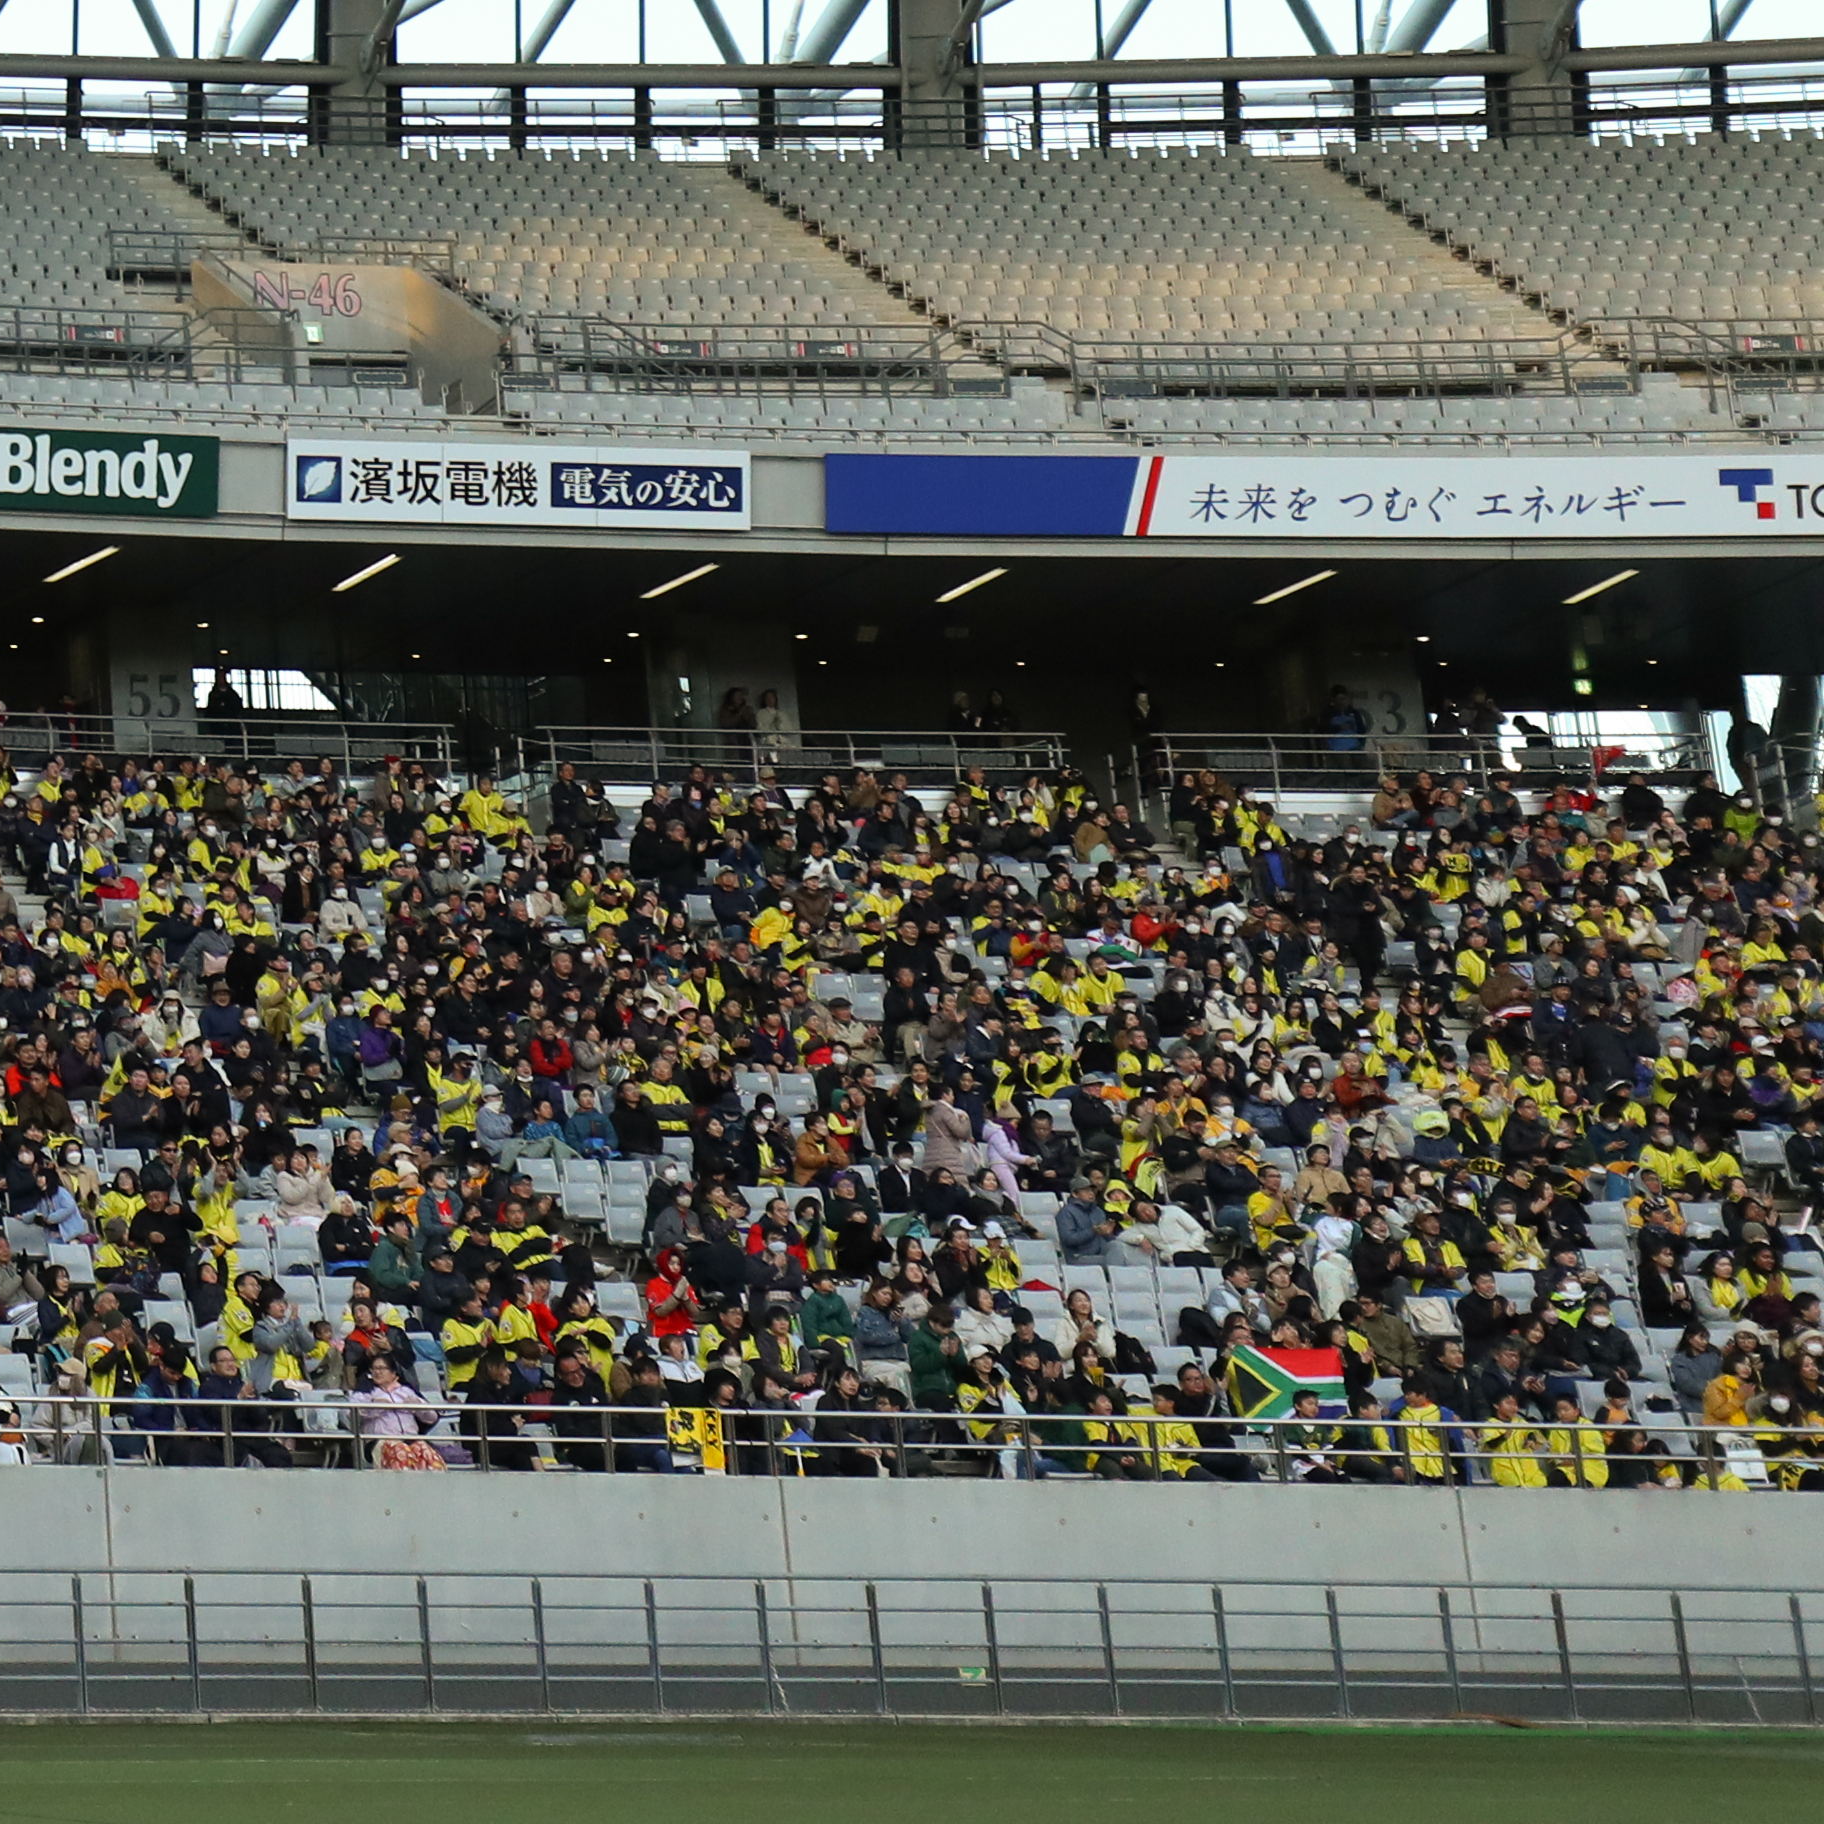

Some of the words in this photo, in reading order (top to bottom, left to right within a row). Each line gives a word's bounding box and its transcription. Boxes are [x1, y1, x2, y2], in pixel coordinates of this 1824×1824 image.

[255, 272, 363, 317] N-46
[349, 456, 538, 509] 濱坂電機
[559, 465, 736, 510] 電気の安心
[1189, 483, 1318, 525] 未来を
[1339, 486, 1457, 523] つむぐ
[1475, 483, 1687, 521] エネルギー
[126, 673, 182, 719] 55
